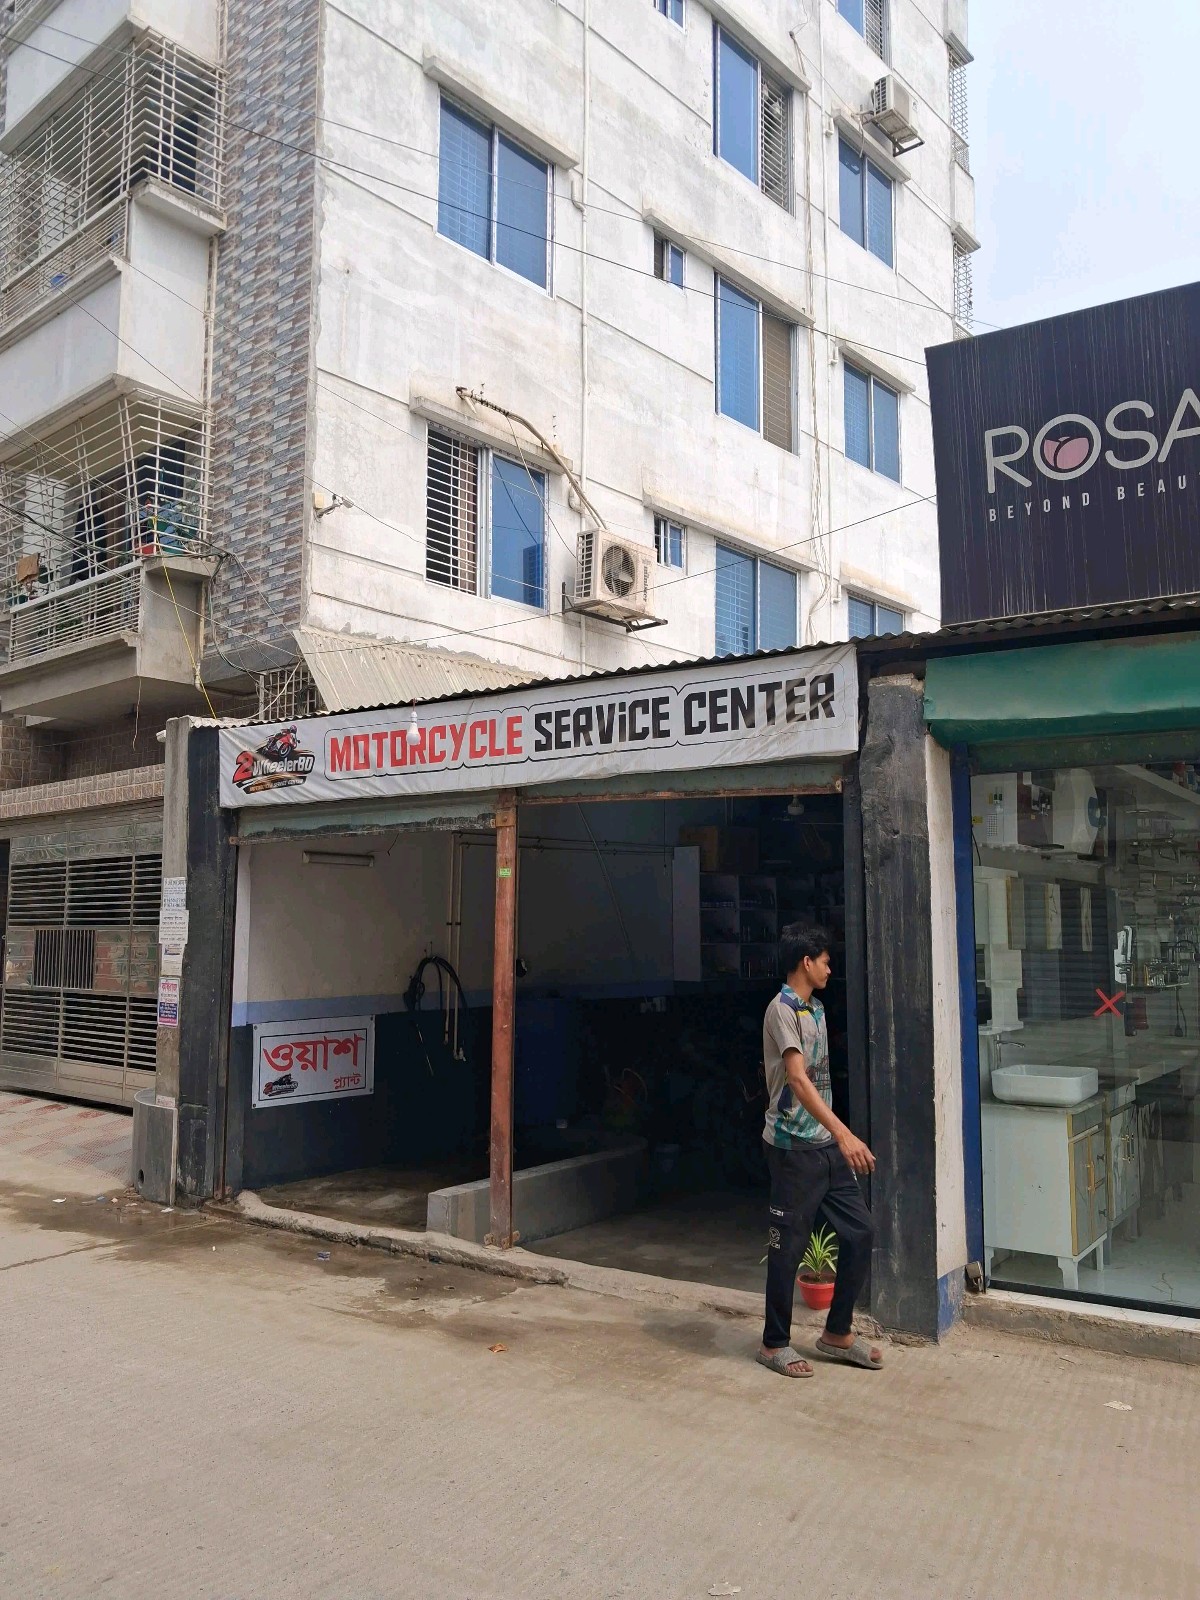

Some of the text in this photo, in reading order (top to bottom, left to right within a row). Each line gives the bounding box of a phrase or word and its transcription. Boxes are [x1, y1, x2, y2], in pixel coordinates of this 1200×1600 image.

[984, 388, 1200, 494] ROSA
[989, 472, 1200, 522] BEYOND BEAU
[330, 715, 523, 773] MOTORCYCLE
[684, 672, 836, 736] CENTER
[263, 1033, 365, 1072] ওয়াশ
[333, 1073, 362, 1090] প্ল্যান্ট
